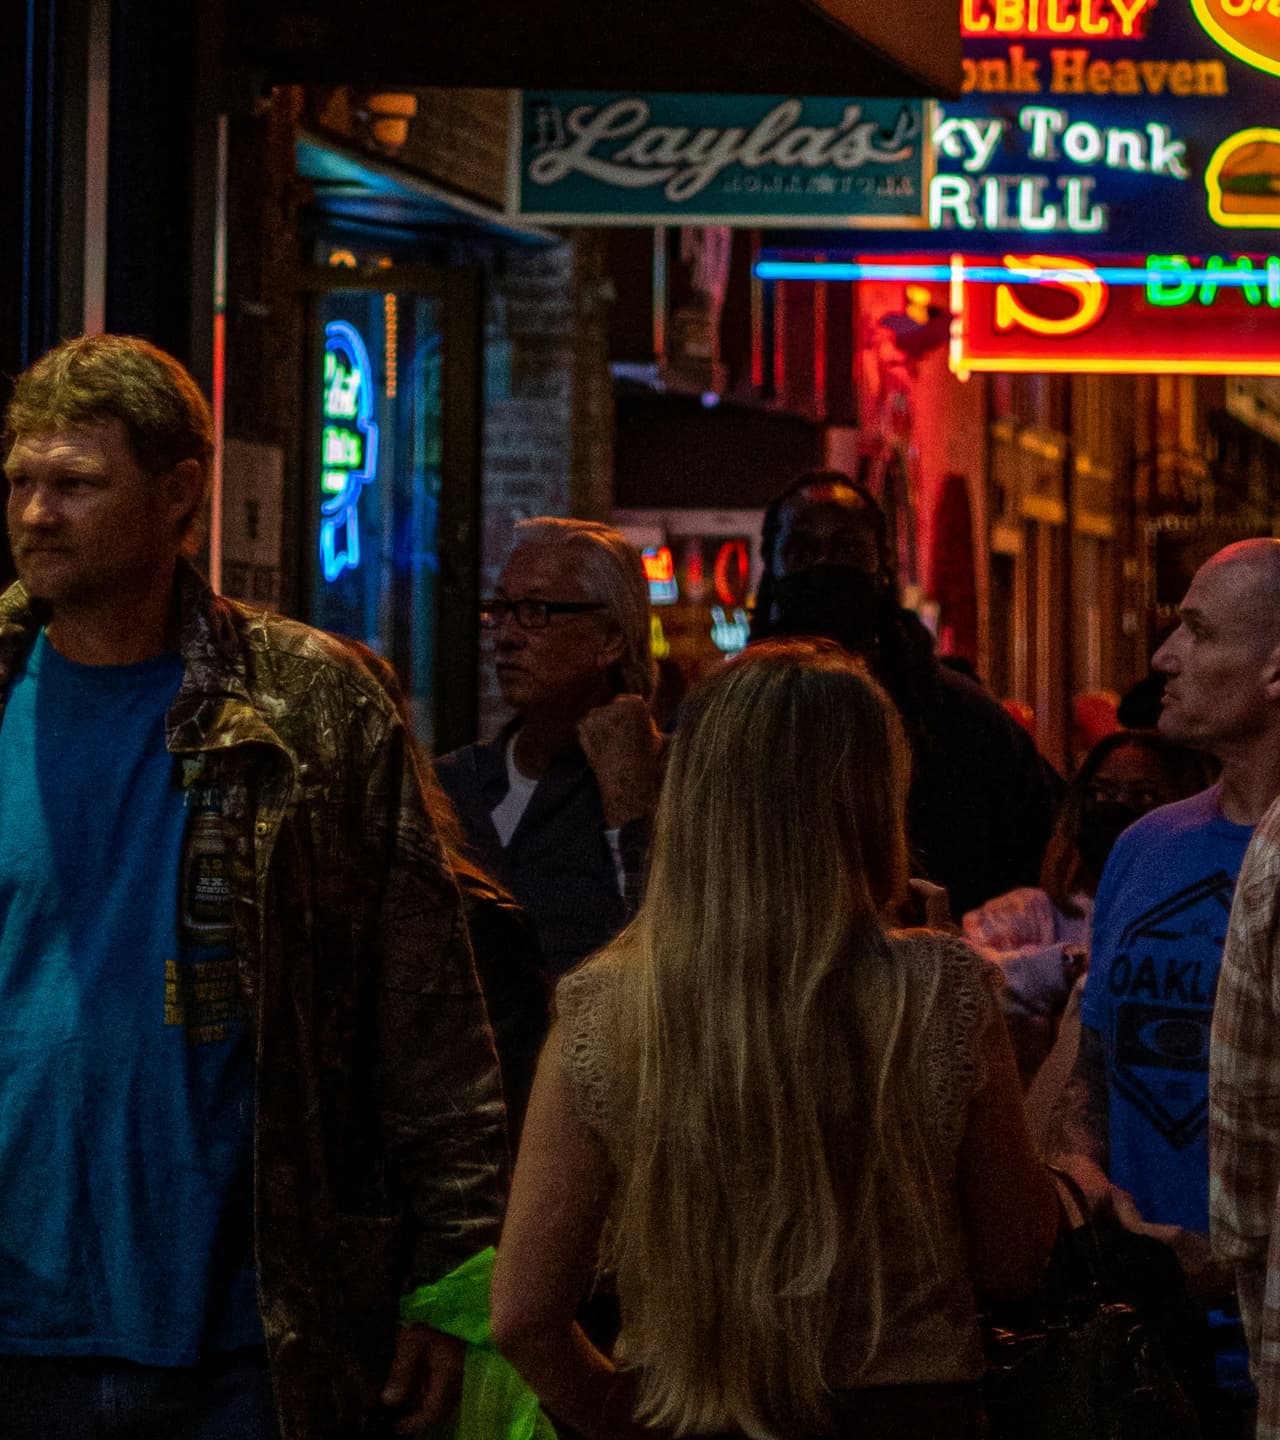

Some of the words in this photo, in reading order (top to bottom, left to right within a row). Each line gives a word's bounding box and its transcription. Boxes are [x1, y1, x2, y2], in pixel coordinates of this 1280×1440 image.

[1050, 47, 1228, 96] Heaven
[528, 97, 913, 203] Layla's
[1019, 105, 1190, 180] Tonk
